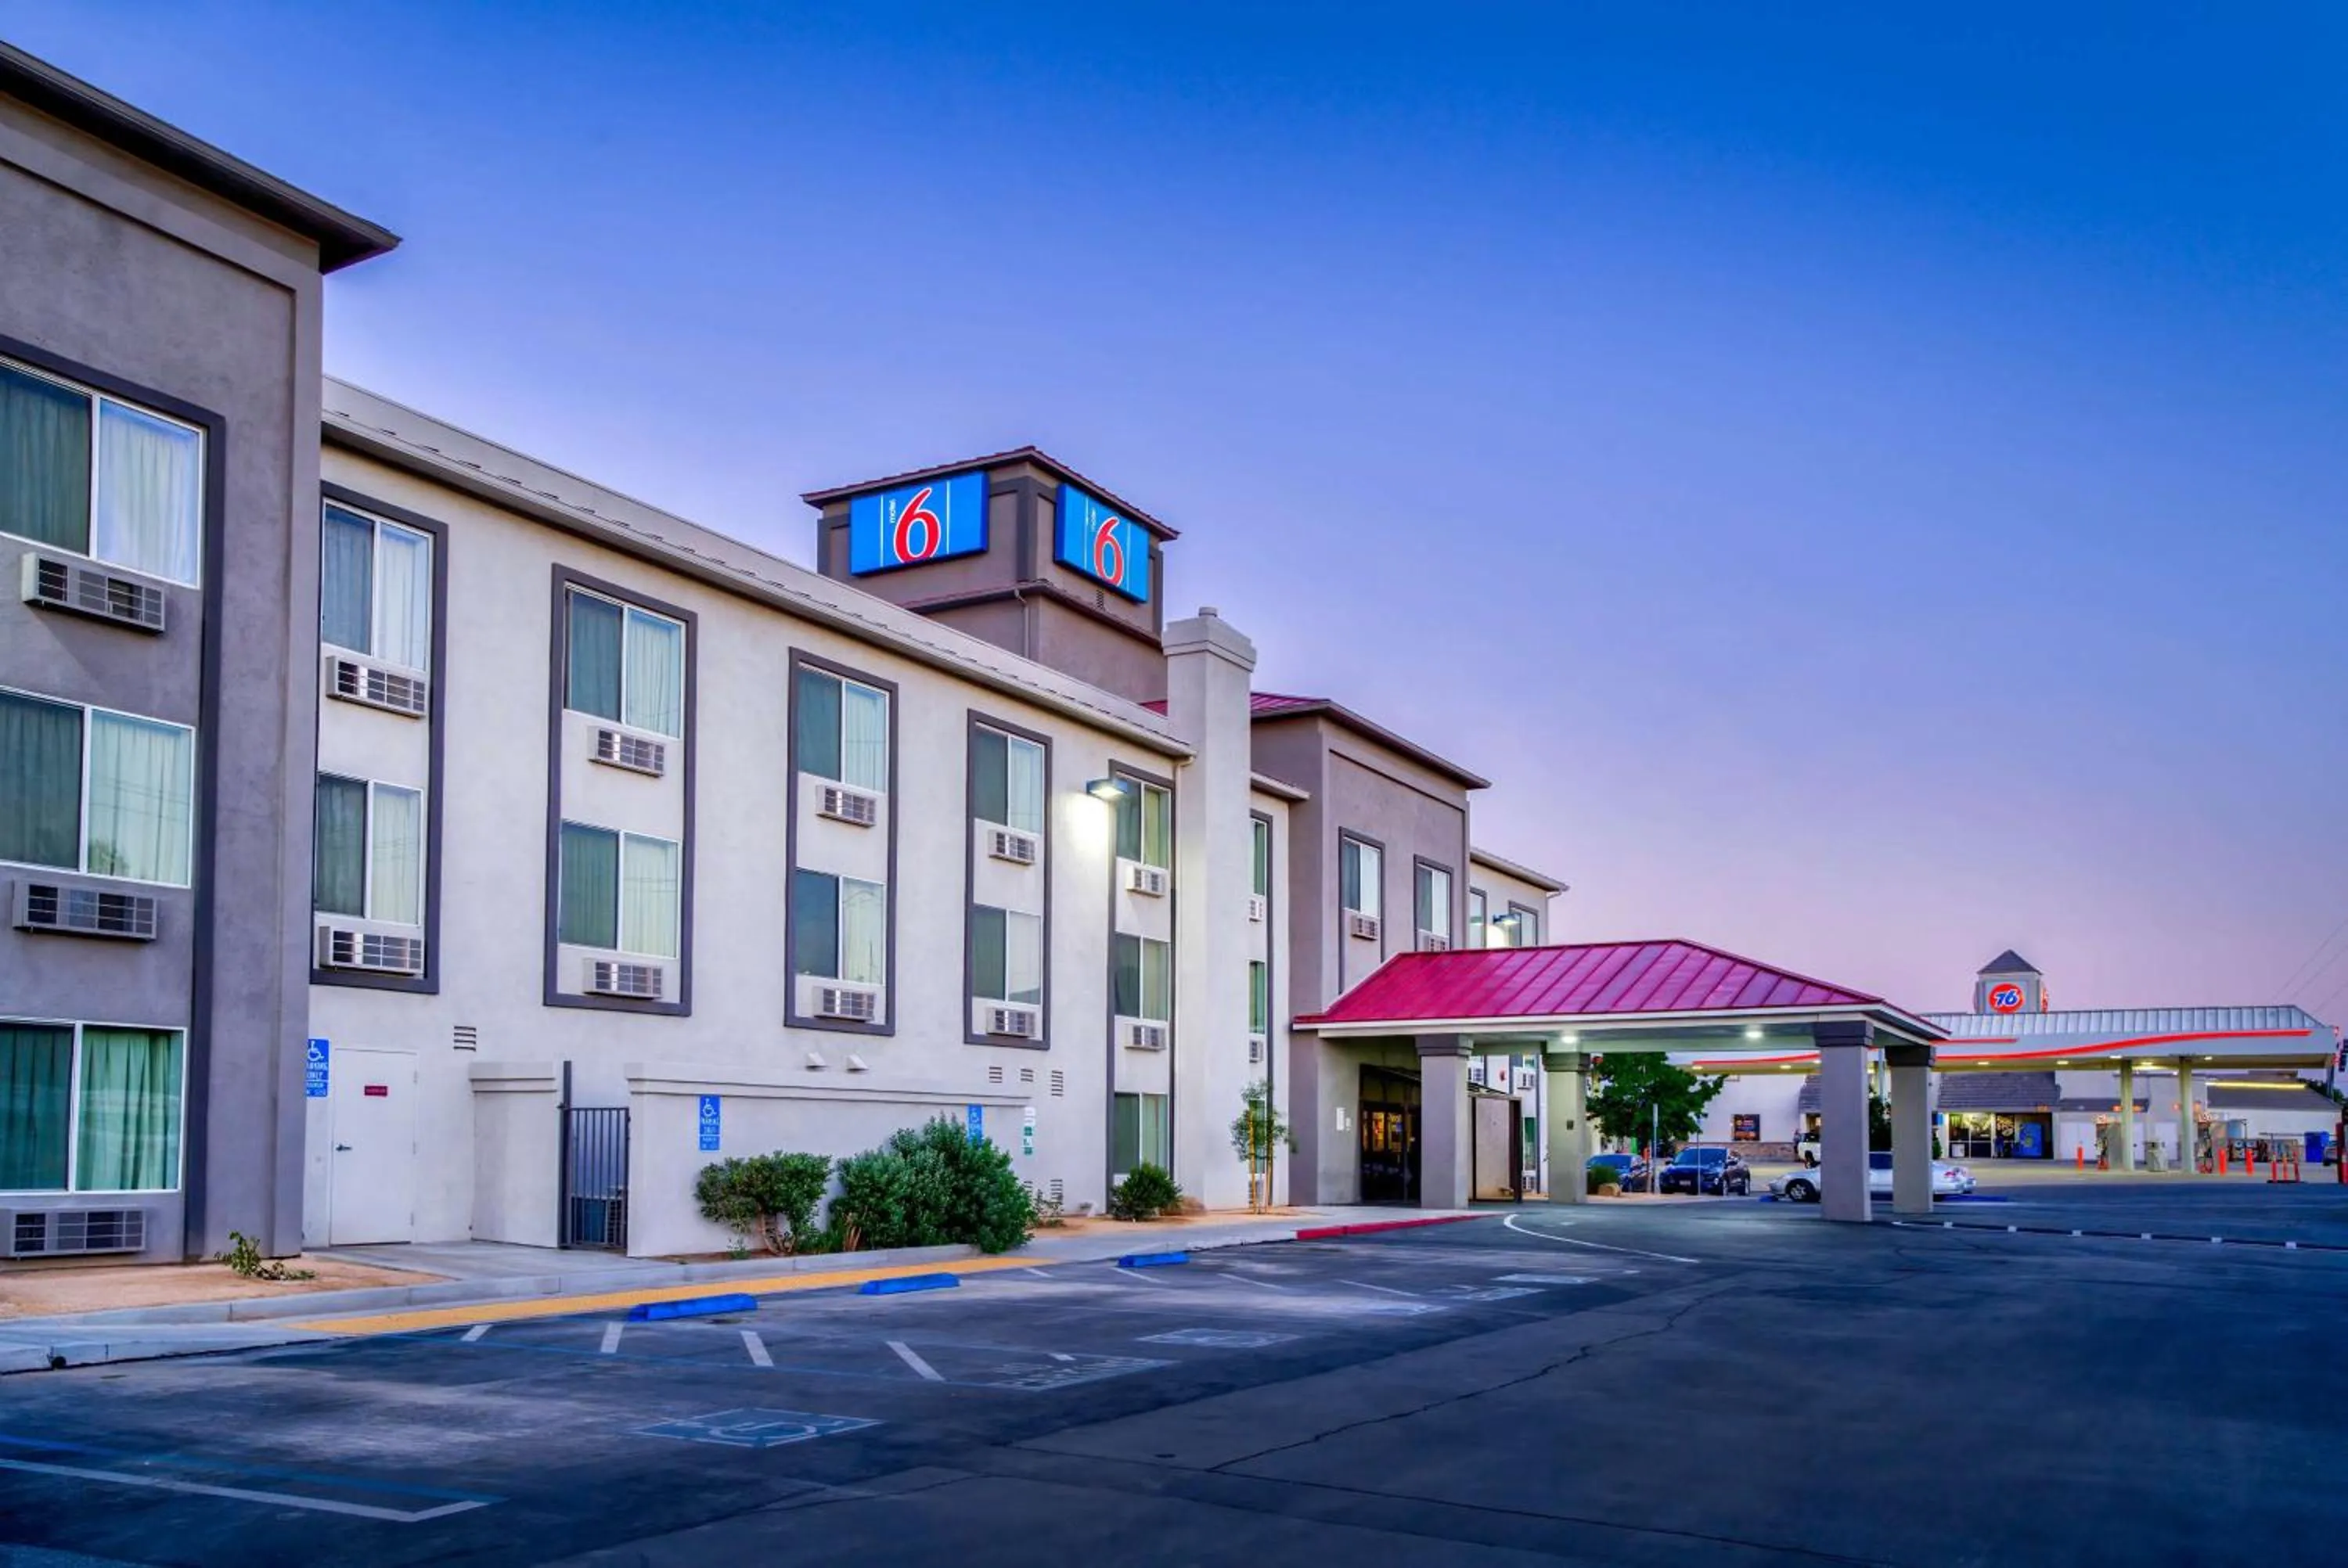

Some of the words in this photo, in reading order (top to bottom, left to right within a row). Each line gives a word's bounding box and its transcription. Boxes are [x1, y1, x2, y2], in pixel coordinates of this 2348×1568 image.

[894, 487, 941, 563] 6
[1093, 516, 1124, 587] 6
[1993, 988, 2020, 1008] 76
